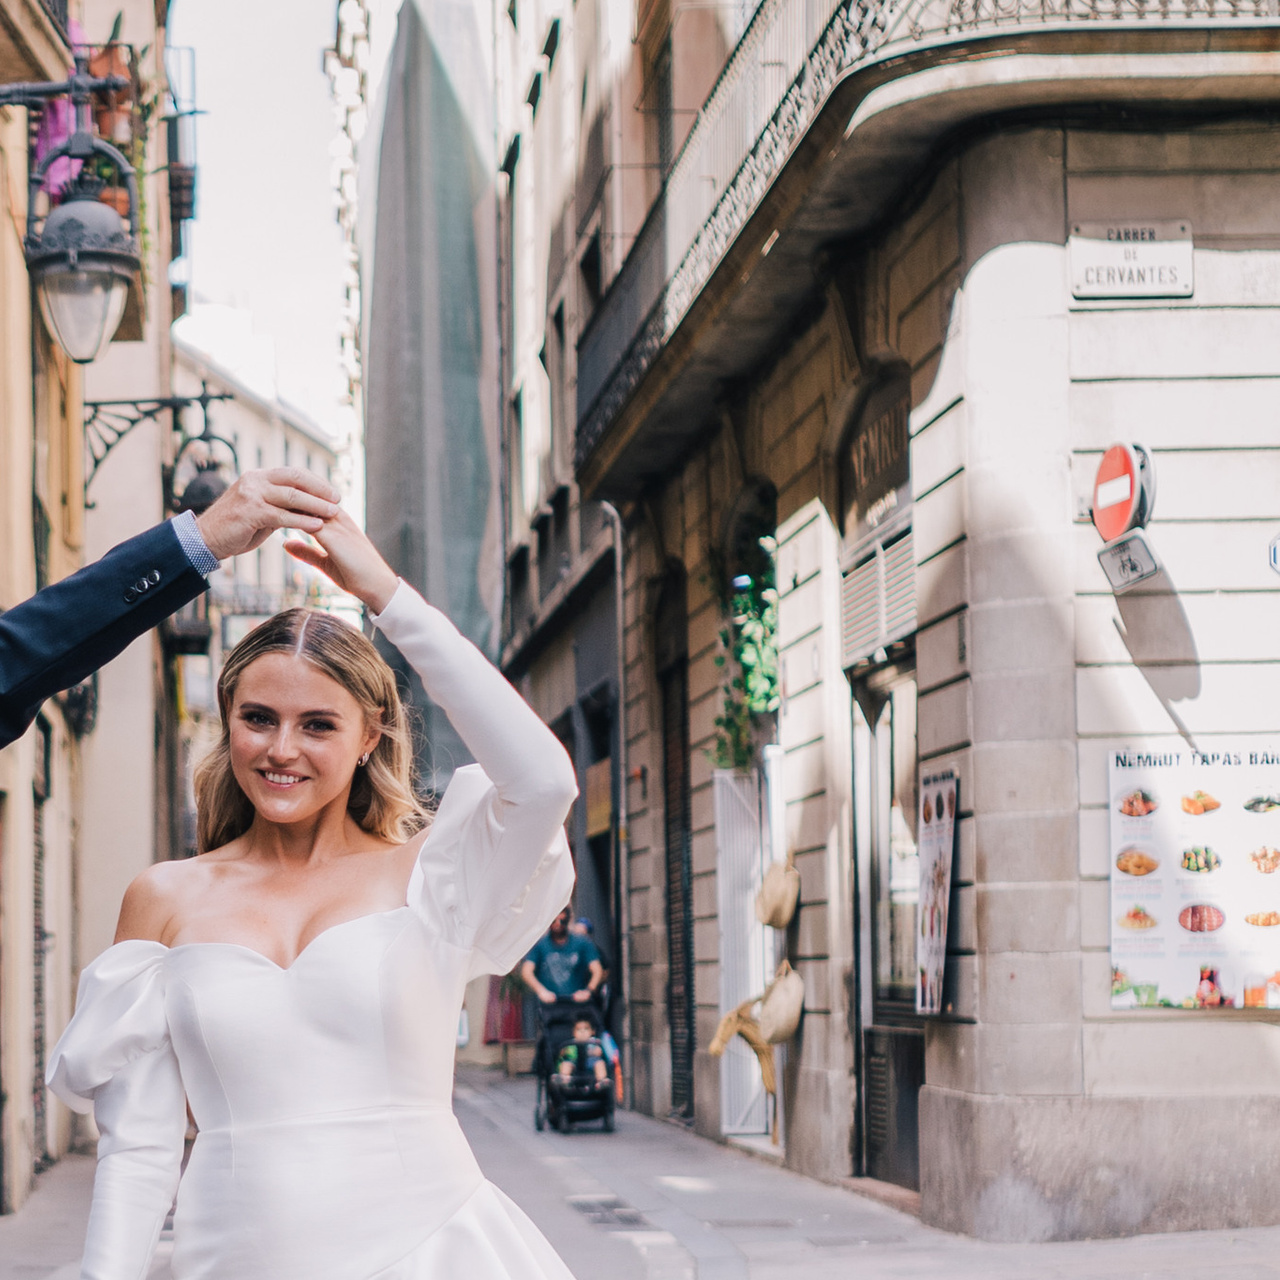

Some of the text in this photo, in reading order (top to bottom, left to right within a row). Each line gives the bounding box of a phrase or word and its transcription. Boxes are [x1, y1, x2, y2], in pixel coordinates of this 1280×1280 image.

[1107, 228, 1156, 241] CARRER
[1124, 248, 1138, 261] DE
[1085, 266, 1178, 285] CERVANTES
[1115, 752, 1181, 768] NEMRUT
[1191, 751, 1241, 766] TAPAS
